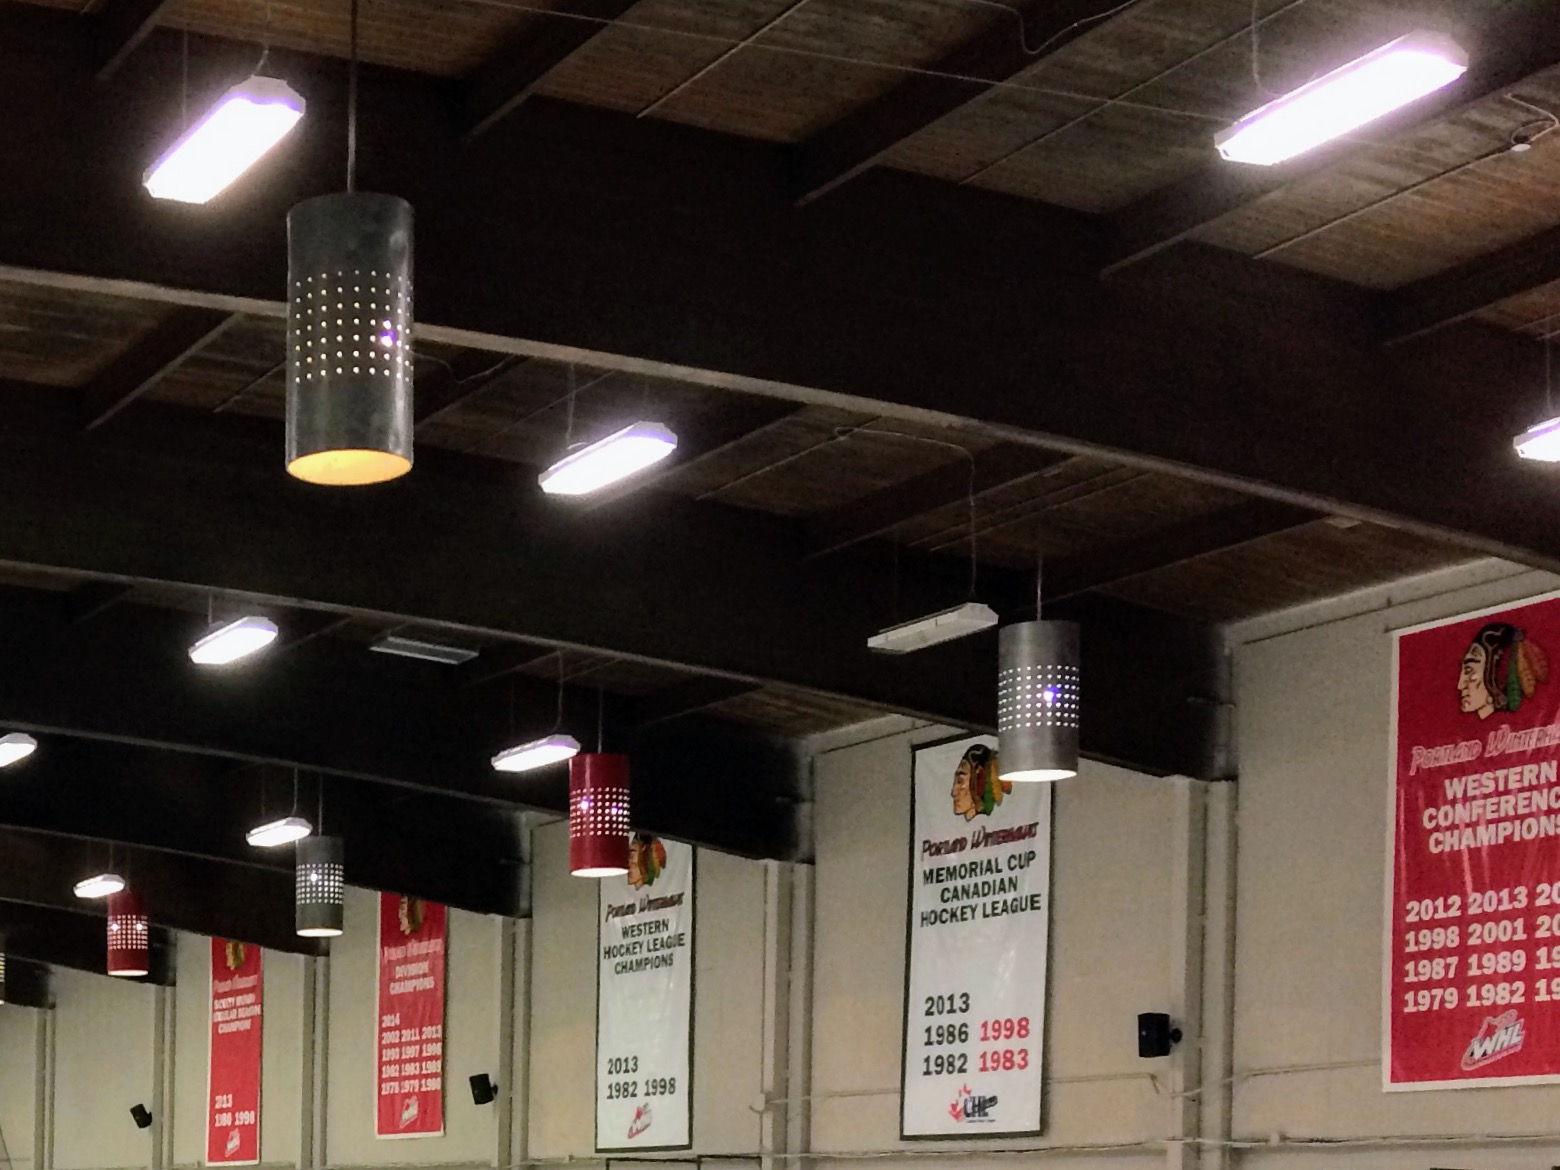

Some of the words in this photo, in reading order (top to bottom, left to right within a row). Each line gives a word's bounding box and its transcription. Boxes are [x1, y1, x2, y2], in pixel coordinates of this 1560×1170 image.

[1444, 760, 1559, 801] WESTERN
[1422, 785, 1560, 830] CONFERENC
[923, 857, 1003, 886] MEMORIAL
[1007, 850, 1037, 871] CUP
[940, 875, 1018, 904] CANADIAN
[1405, 894, 1462, 924] 2012
[1468, 885, 1528, 916] 2013
[1535, 882, 1560, 907] 20
[920, 903, 978, 928] HOCKEY
[982, 893, 1042, 919] LEAGUE
[621, 918, 670, 939] WESTERN
[1404, 925, 1460, 953] 1998
[1467, 917, 1528, 946] 2001
[1535, 914, 1560, 939] 20
[603, 940, 644, 960] HOCKEY
[646, 932, 685, 953] LEAGUE
[614, 952, 674, 975] CHAMPIONS
[1404, 955, 1459, 983] 1987
[1467, 949, 1527, 977] 1989
[924, 992, 970, 1016] 2013
[1403, 987, 1459, 1013] 1979
[1466, 980, 1526, 1007] 1982
[924, 1022, 969, 1046] 1986
[980, 1017, 1030, 1041] 1998
[1470, 1021, 1525, 1060] WHL
[607, 1055, 638, 1075] 2013
[923, 1053, 968, 1076] 1982
[979, 1048, 1029, 1072] 1983
[606, 1080, 638, 1100] 1982
[643, 1076, 676, 1097] 1998
